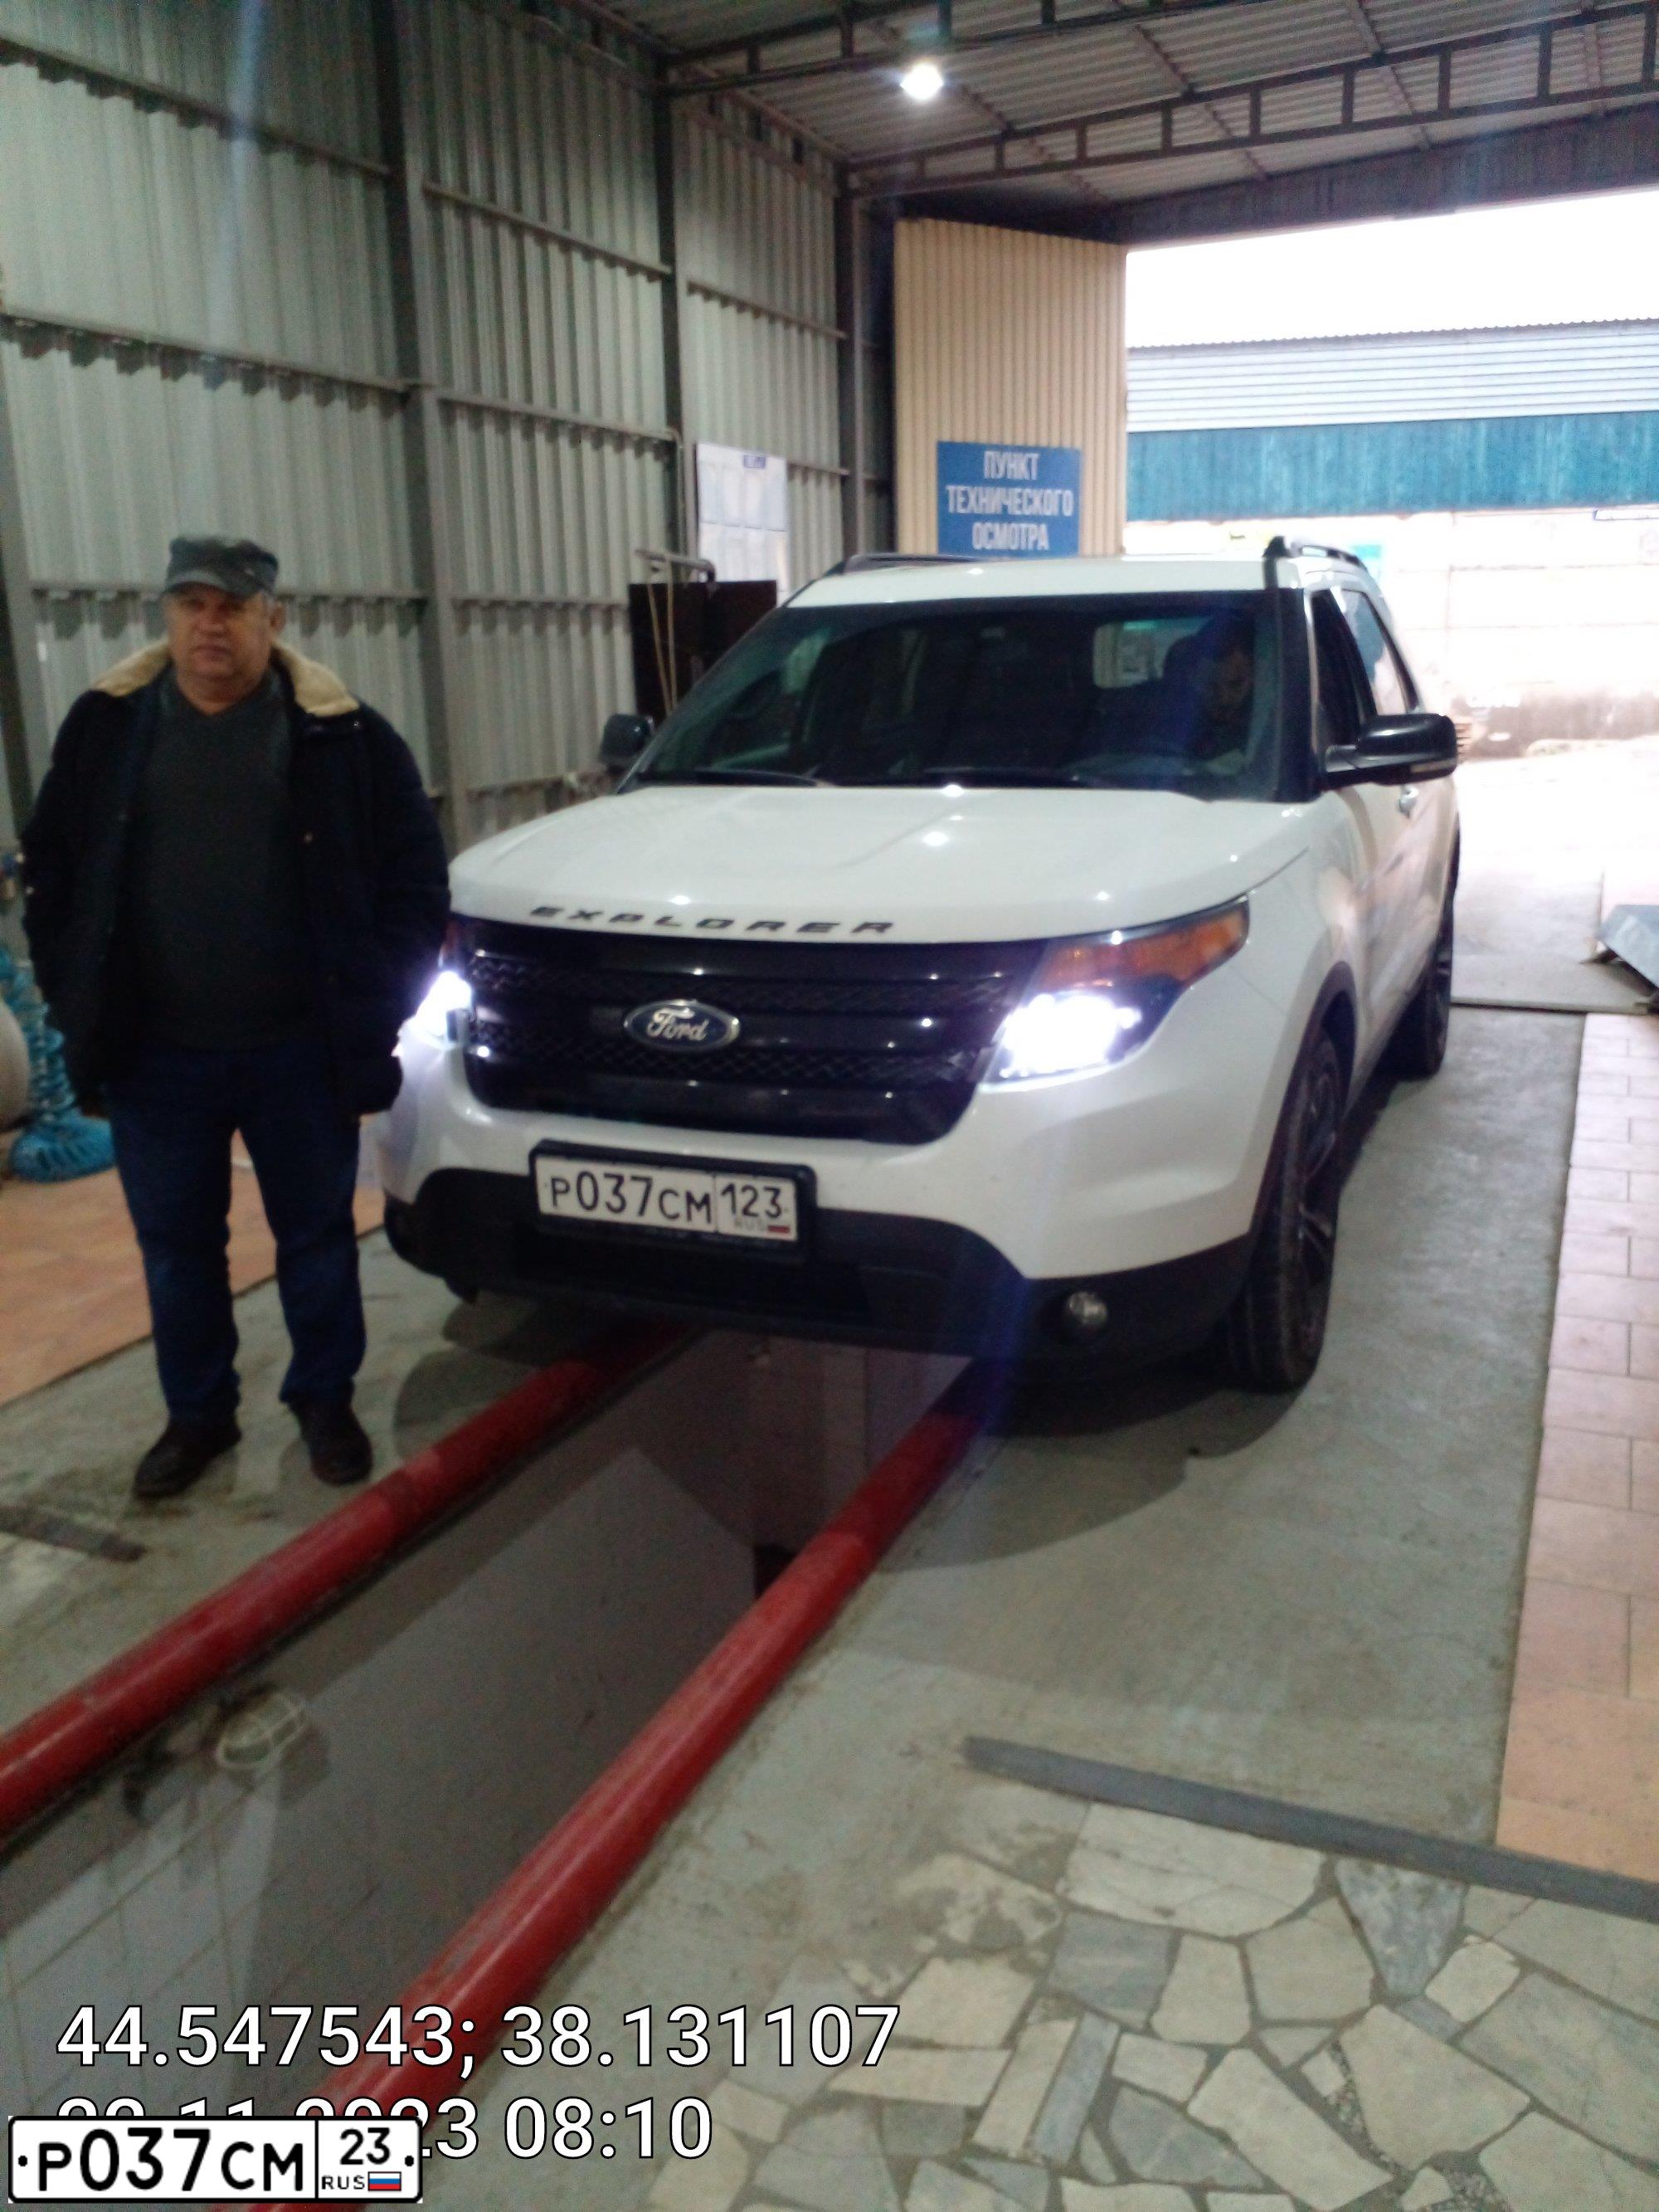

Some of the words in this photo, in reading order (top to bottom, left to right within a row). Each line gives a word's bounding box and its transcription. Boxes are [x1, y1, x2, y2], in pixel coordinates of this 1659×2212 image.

[983, 451, 1040, 480] ПУНКТ
[946, 485, 1074, 516] ТЕХНИЧЕСКОГО
[971, 522, 1049, 551] ОСМОТРА
[530, 906, 894, 933] EXPLORER
[646, 1006, 710, 1042] Ford
